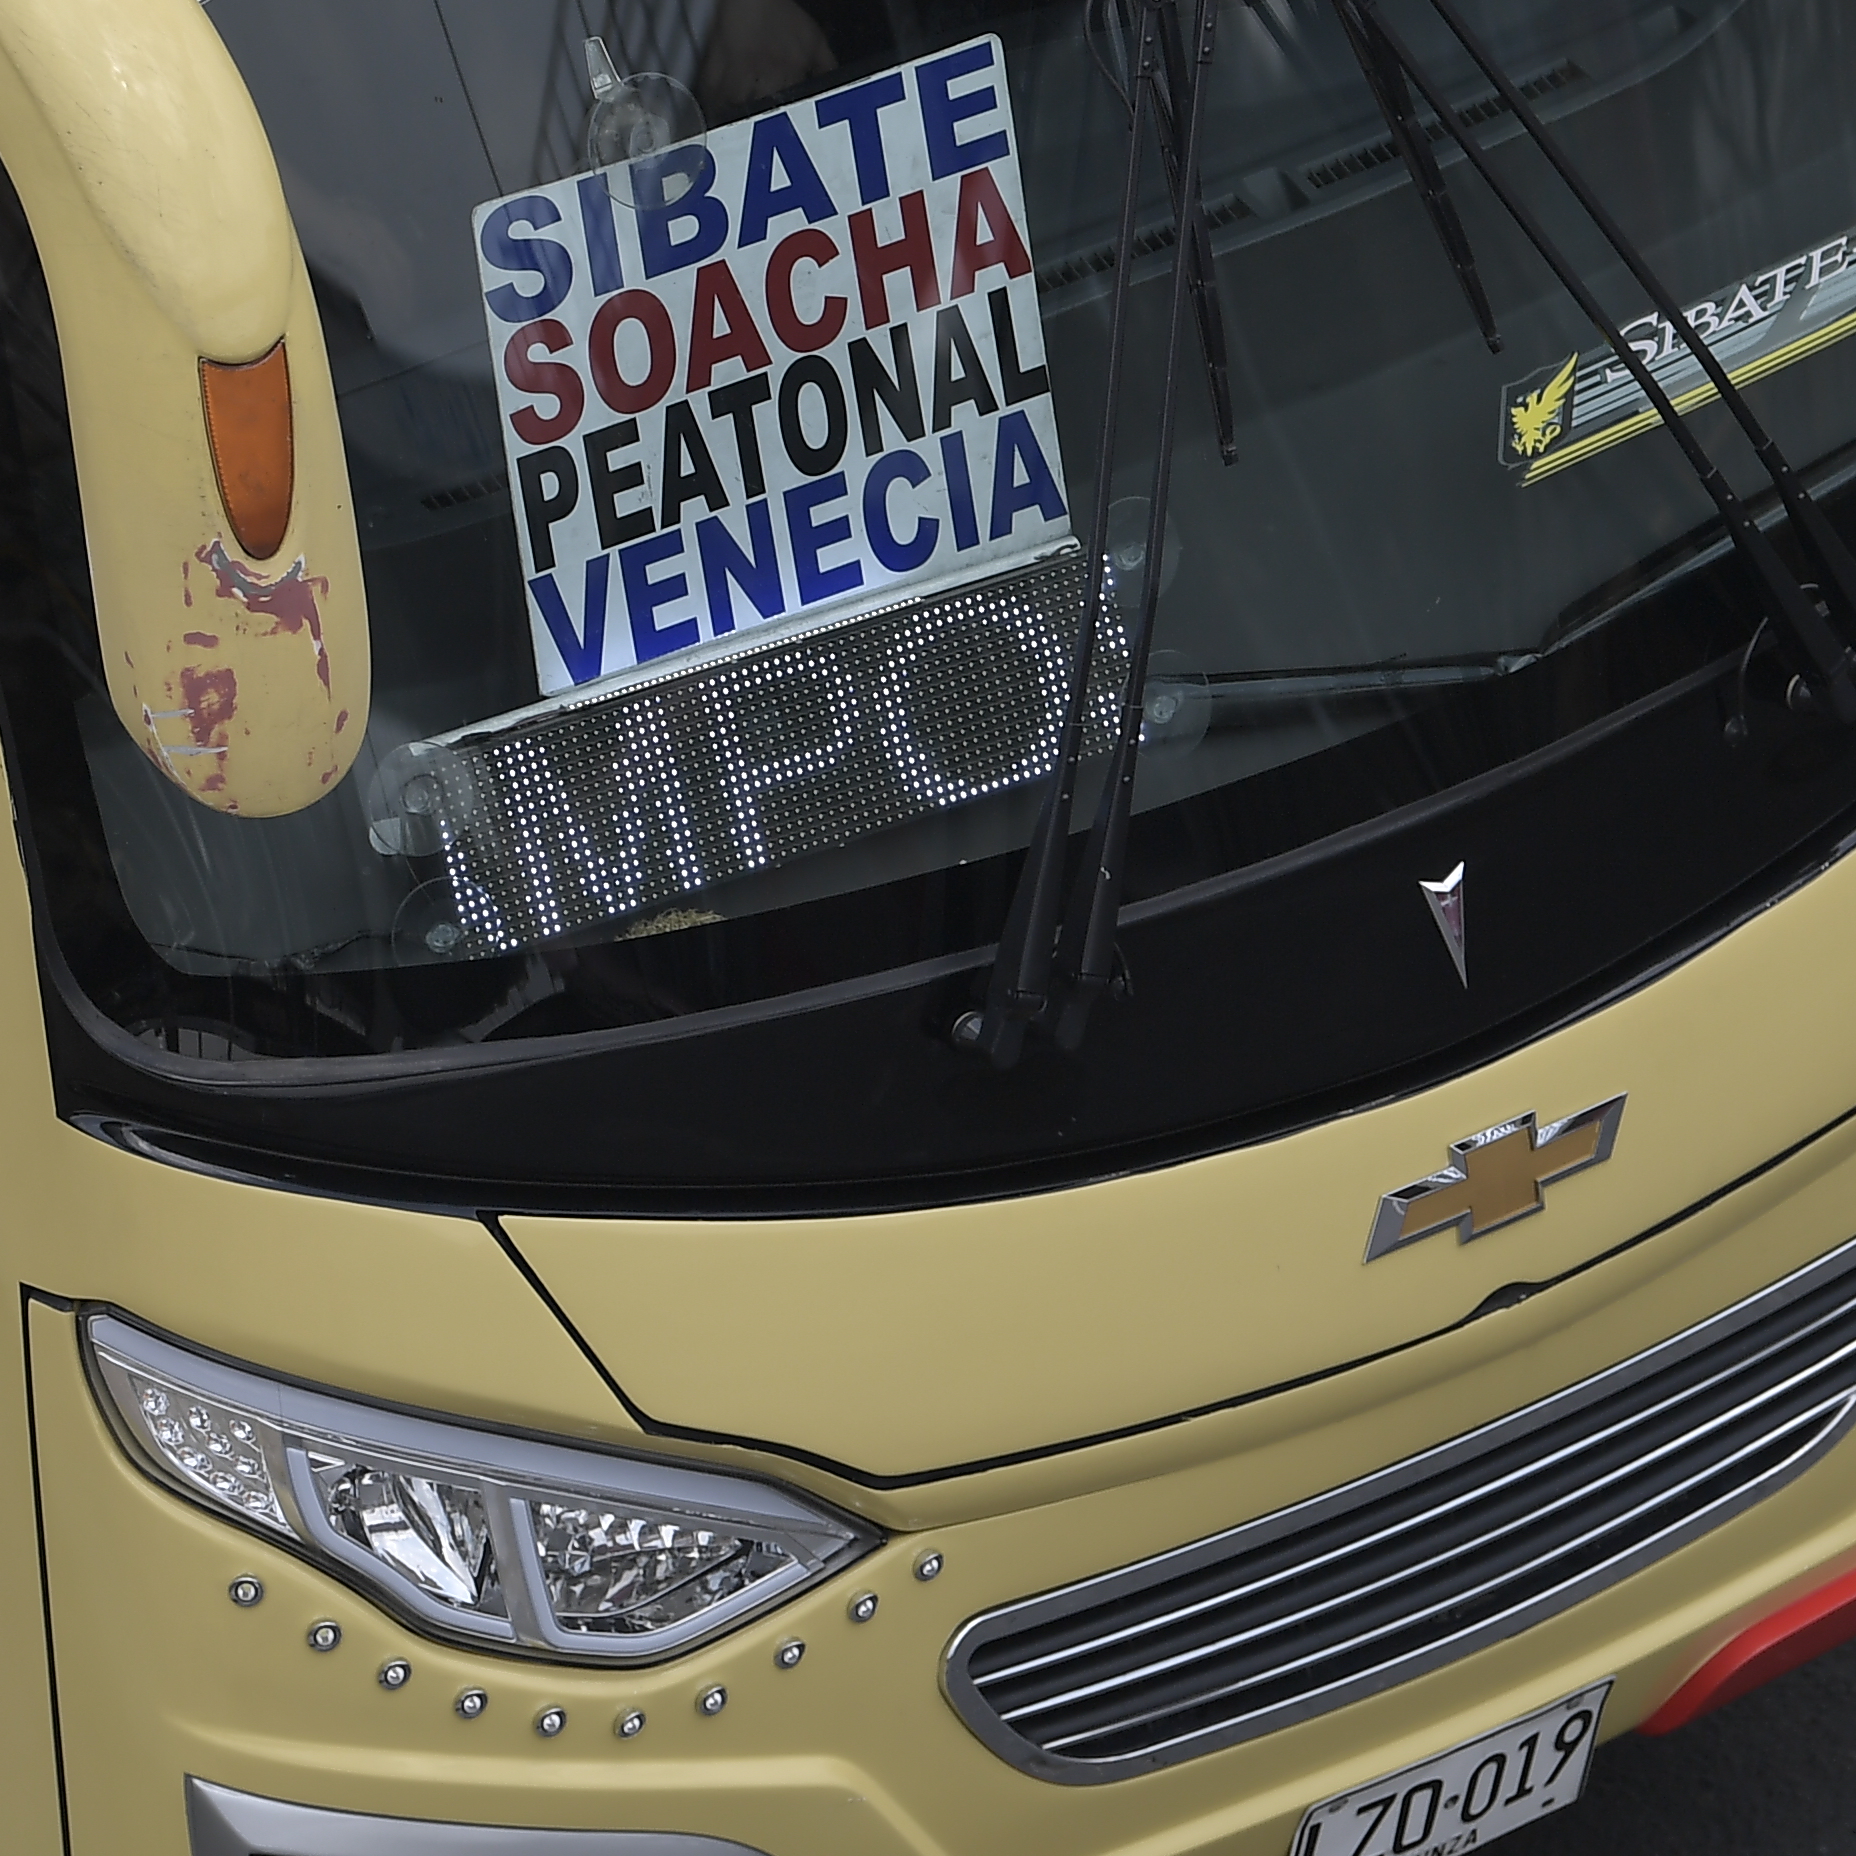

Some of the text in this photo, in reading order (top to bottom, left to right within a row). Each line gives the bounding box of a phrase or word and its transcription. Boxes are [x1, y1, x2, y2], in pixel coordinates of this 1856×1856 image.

[477, 40, 1010, 326] SIBATE
[502, 165, 1033, 446] SOACHA
[516, 286, 1053, 576] PEATONAL
[527, 408, 1069, 687] VENECIA
